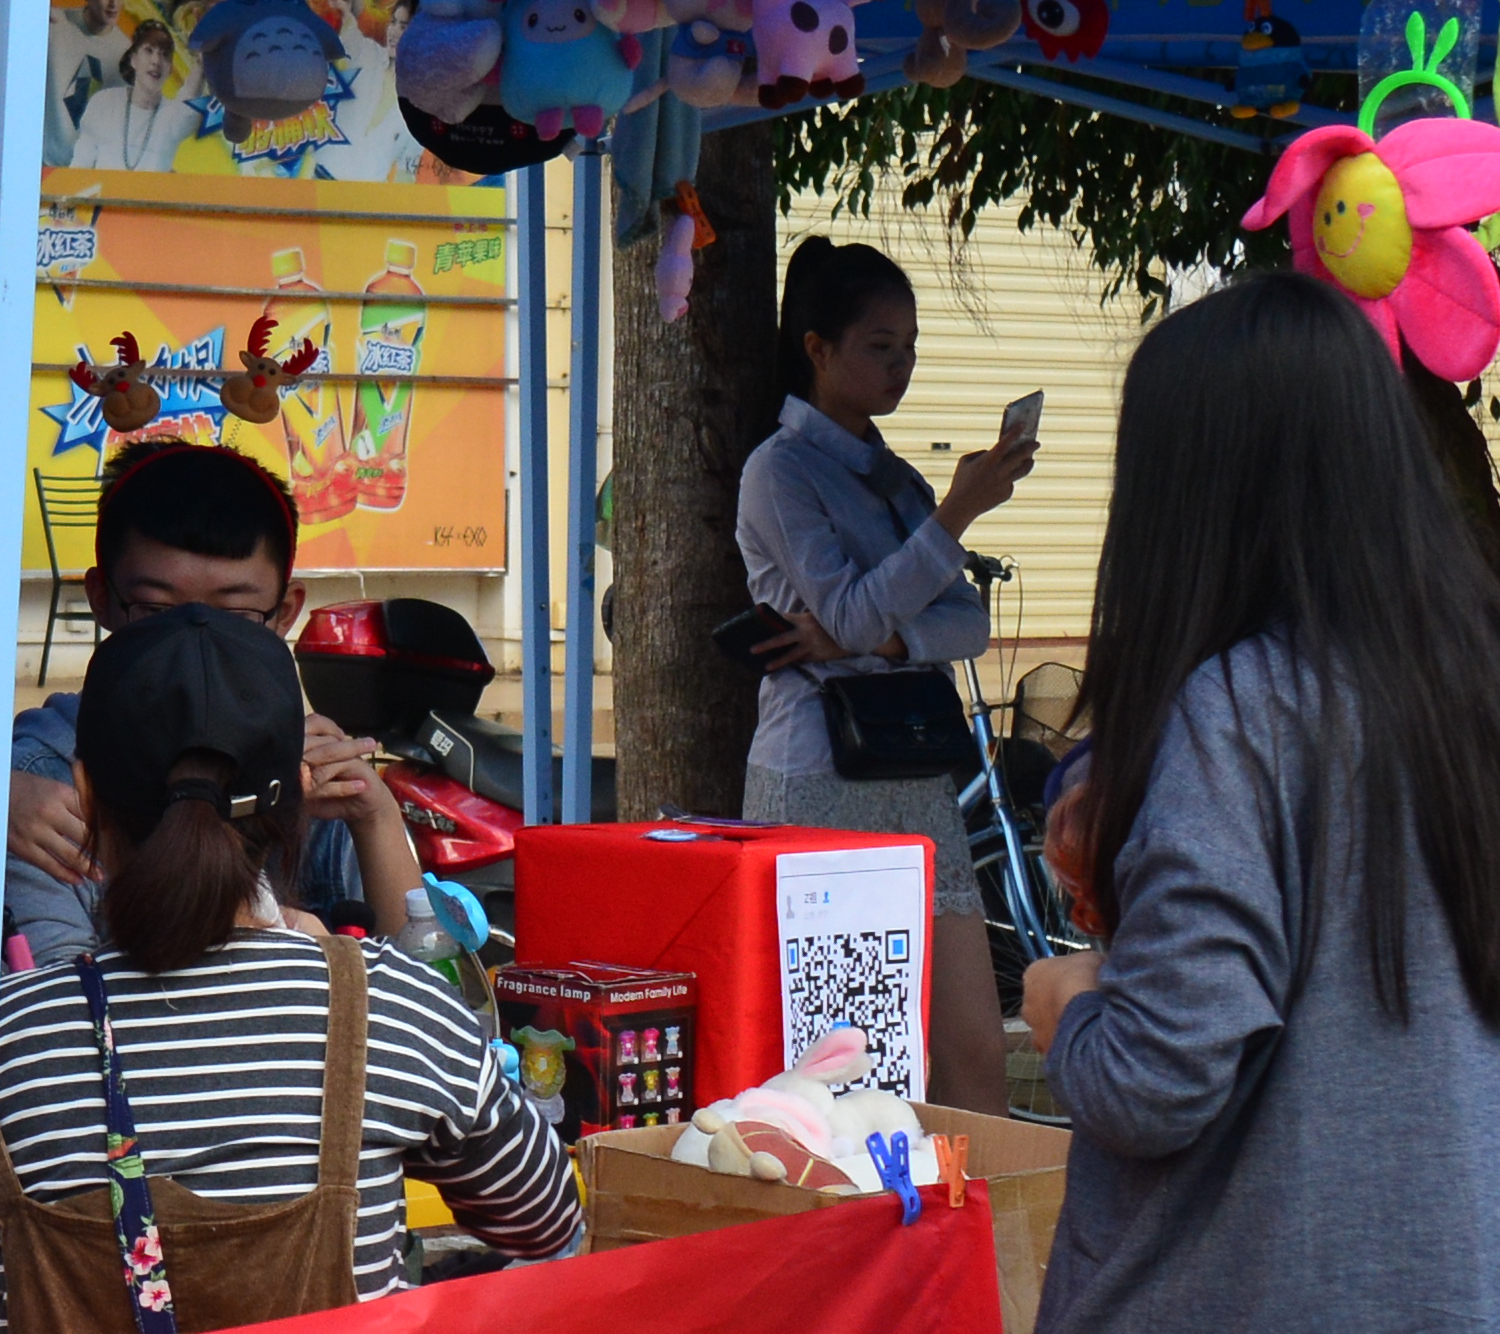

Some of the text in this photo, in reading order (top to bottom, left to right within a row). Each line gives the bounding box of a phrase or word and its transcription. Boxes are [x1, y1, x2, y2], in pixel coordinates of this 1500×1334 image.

[497, 976, 591, 1003] Fragrance lamp
[610, 984, 688, 1003] Modern Family Life
